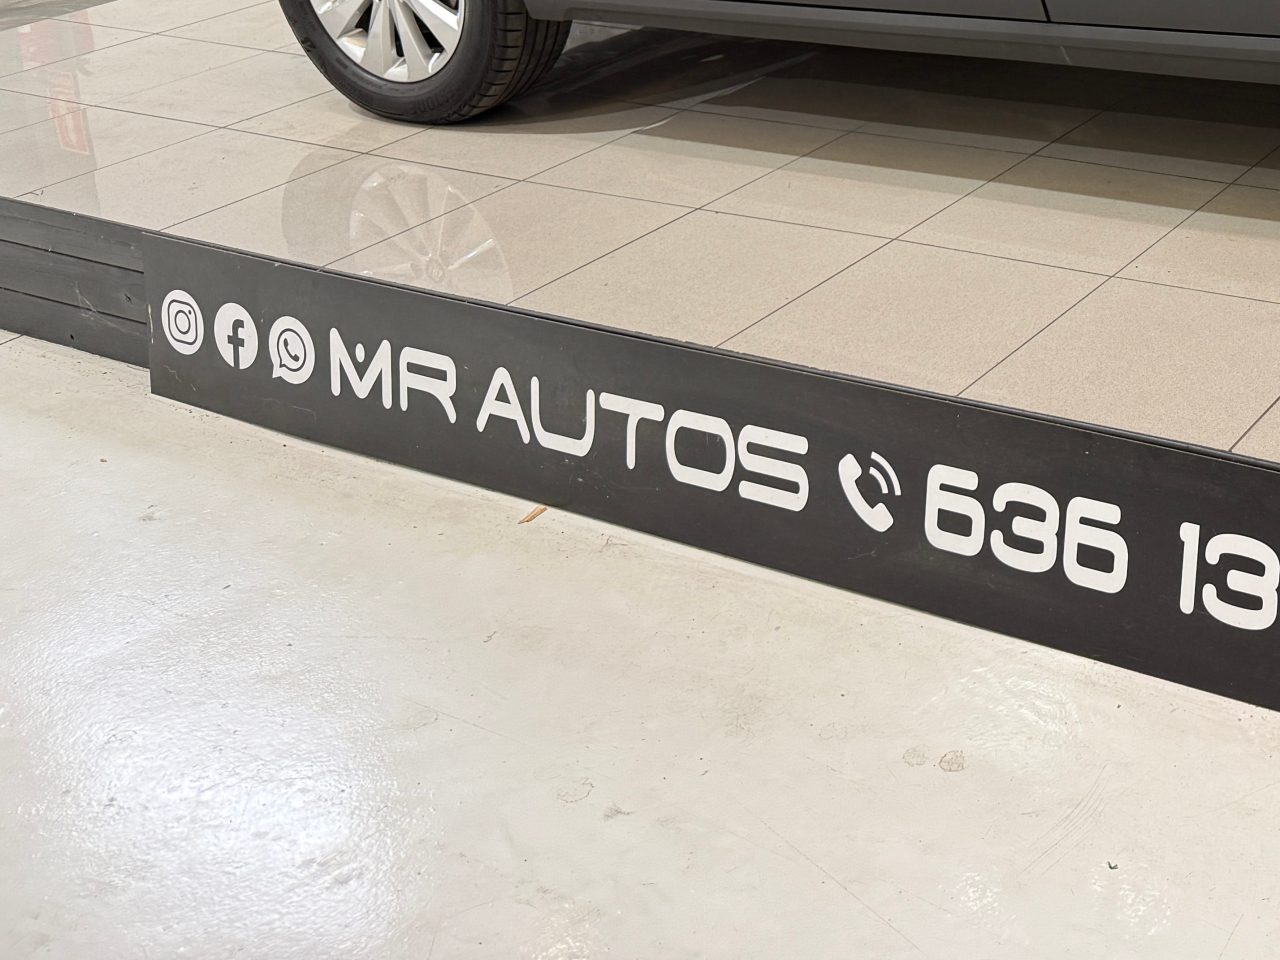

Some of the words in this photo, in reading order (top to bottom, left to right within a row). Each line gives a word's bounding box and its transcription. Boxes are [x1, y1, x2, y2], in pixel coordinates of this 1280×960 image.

[329, 327, 457, 424] MR
[475, 366, 810, 513] AUTOS
[924, 463, 1129, 594] 636
